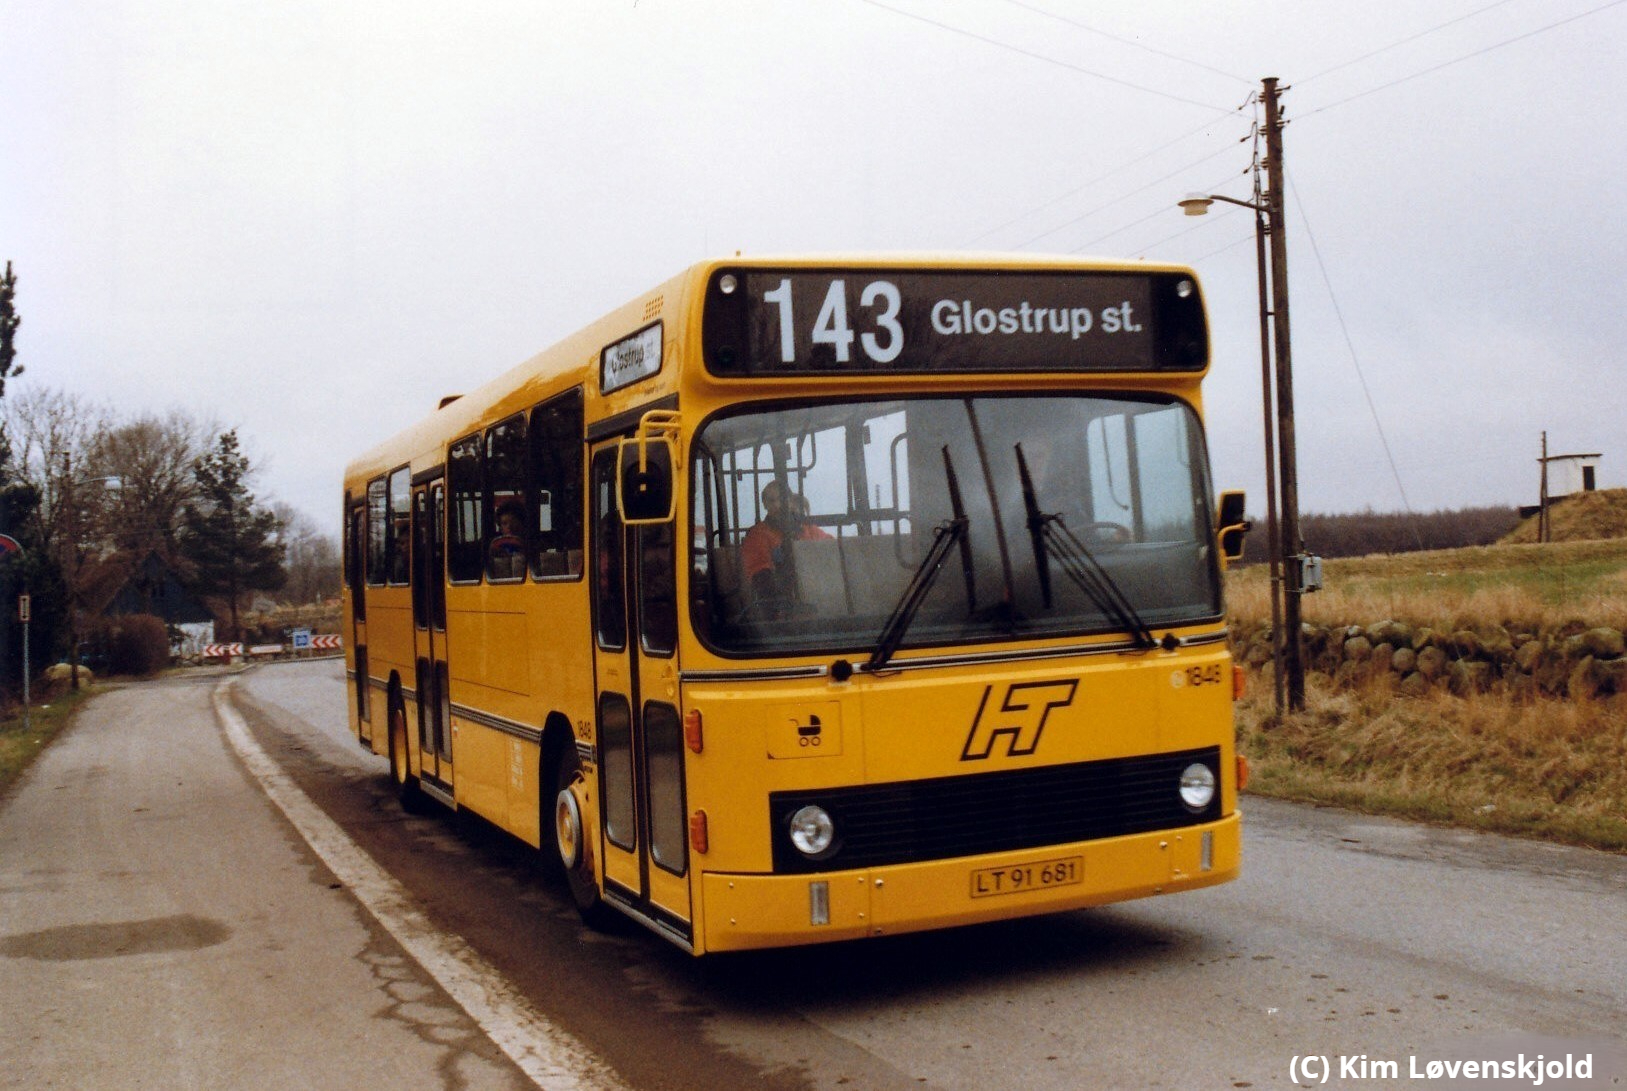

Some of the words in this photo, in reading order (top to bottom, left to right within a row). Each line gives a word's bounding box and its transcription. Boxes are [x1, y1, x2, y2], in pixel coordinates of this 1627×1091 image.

[764, 278, 904, 364] 143
[930, 299, 1093, 340] Glostrup
[1101, 301, 1143, 333] st.
[960, 678, 1080, 762] HT
[976, 871, 1006, 893] LT
[1011, 867, 1033, 887] 91
[1041, 862, 1076, 885] 681
